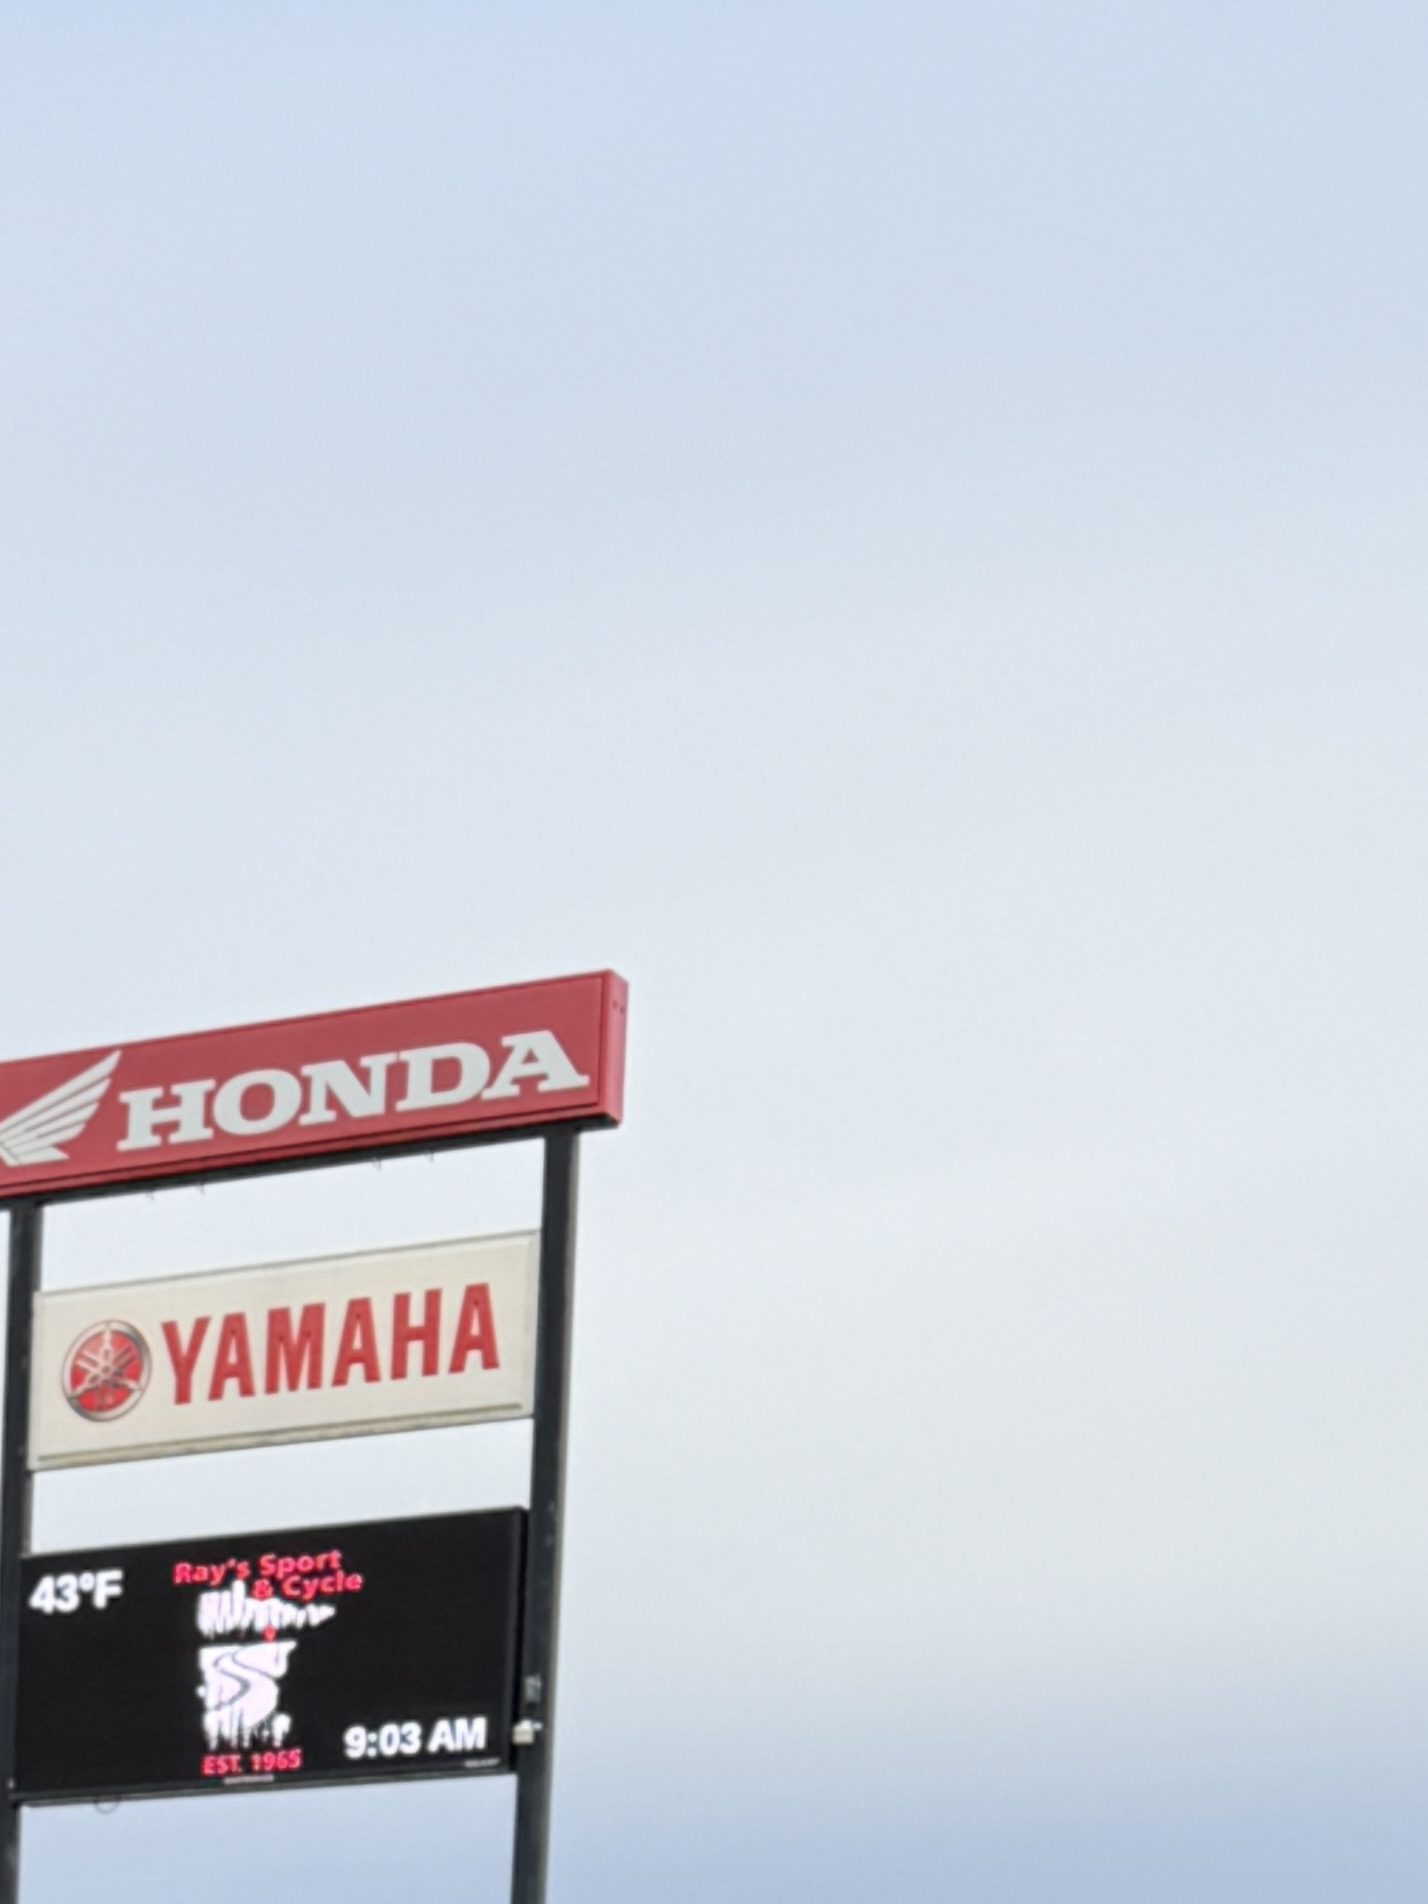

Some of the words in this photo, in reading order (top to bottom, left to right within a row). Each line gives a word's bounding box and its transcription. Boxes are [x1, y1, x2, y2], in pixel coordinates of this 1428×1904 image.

[116, 1029, 590, 1151] HONDA
[161, 1283, 501, 1405] YAMAHA
[171, 1558, 250, 1587] Ray's
[258, 1549, 343, 1580] Sport
[251, 1577, 274, 1600] &
[280, 1567, 364, 1600] Cycle
[343, 1722, 422, 1761] 9:03
[427, 1715, 489, 1752] AM
[200, 1752, 242, 1777] EST.
[250, 1748, 303, 1773] 1965
